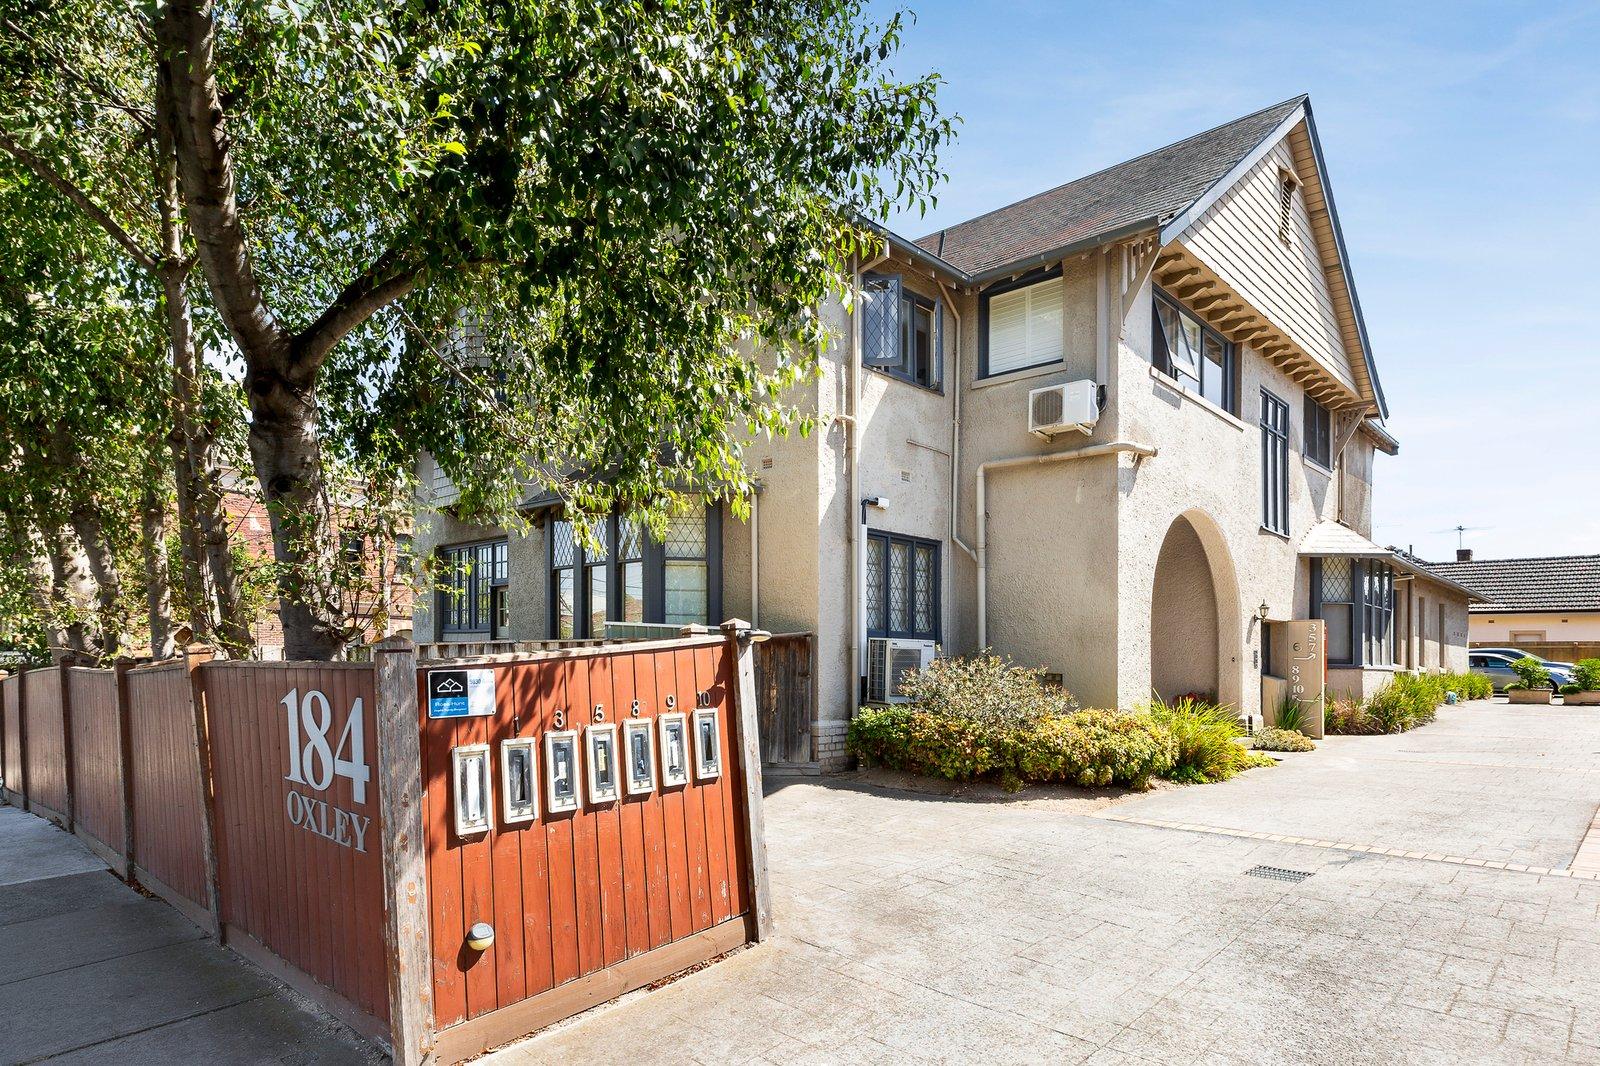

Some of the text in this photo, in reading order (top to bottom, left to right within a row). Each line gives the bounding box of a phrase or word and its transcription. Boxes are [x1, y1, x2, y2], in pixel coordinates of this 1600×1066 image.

[1309, 624, 1317, 632] 3
[1309, 634, 1316, 642] 5
[1293, 642, 1302, 652] 6
[1308, 643, 1316, 651] 7
[1292, 666, 1299, 674] 8
[1292, 675, 1300, 683] 9
[1292, 685, 1304, 694] 10
[666, 694, 676, 710] 9
[698, 691, 711, 706] 10
[595, 704, 605, 722] 5
[632, 700, 640, 716] 8
[554, 710, 564, 729] 3
[280, 687, 370, 805] 184
[286, 790, 370, 853] OXLEY
